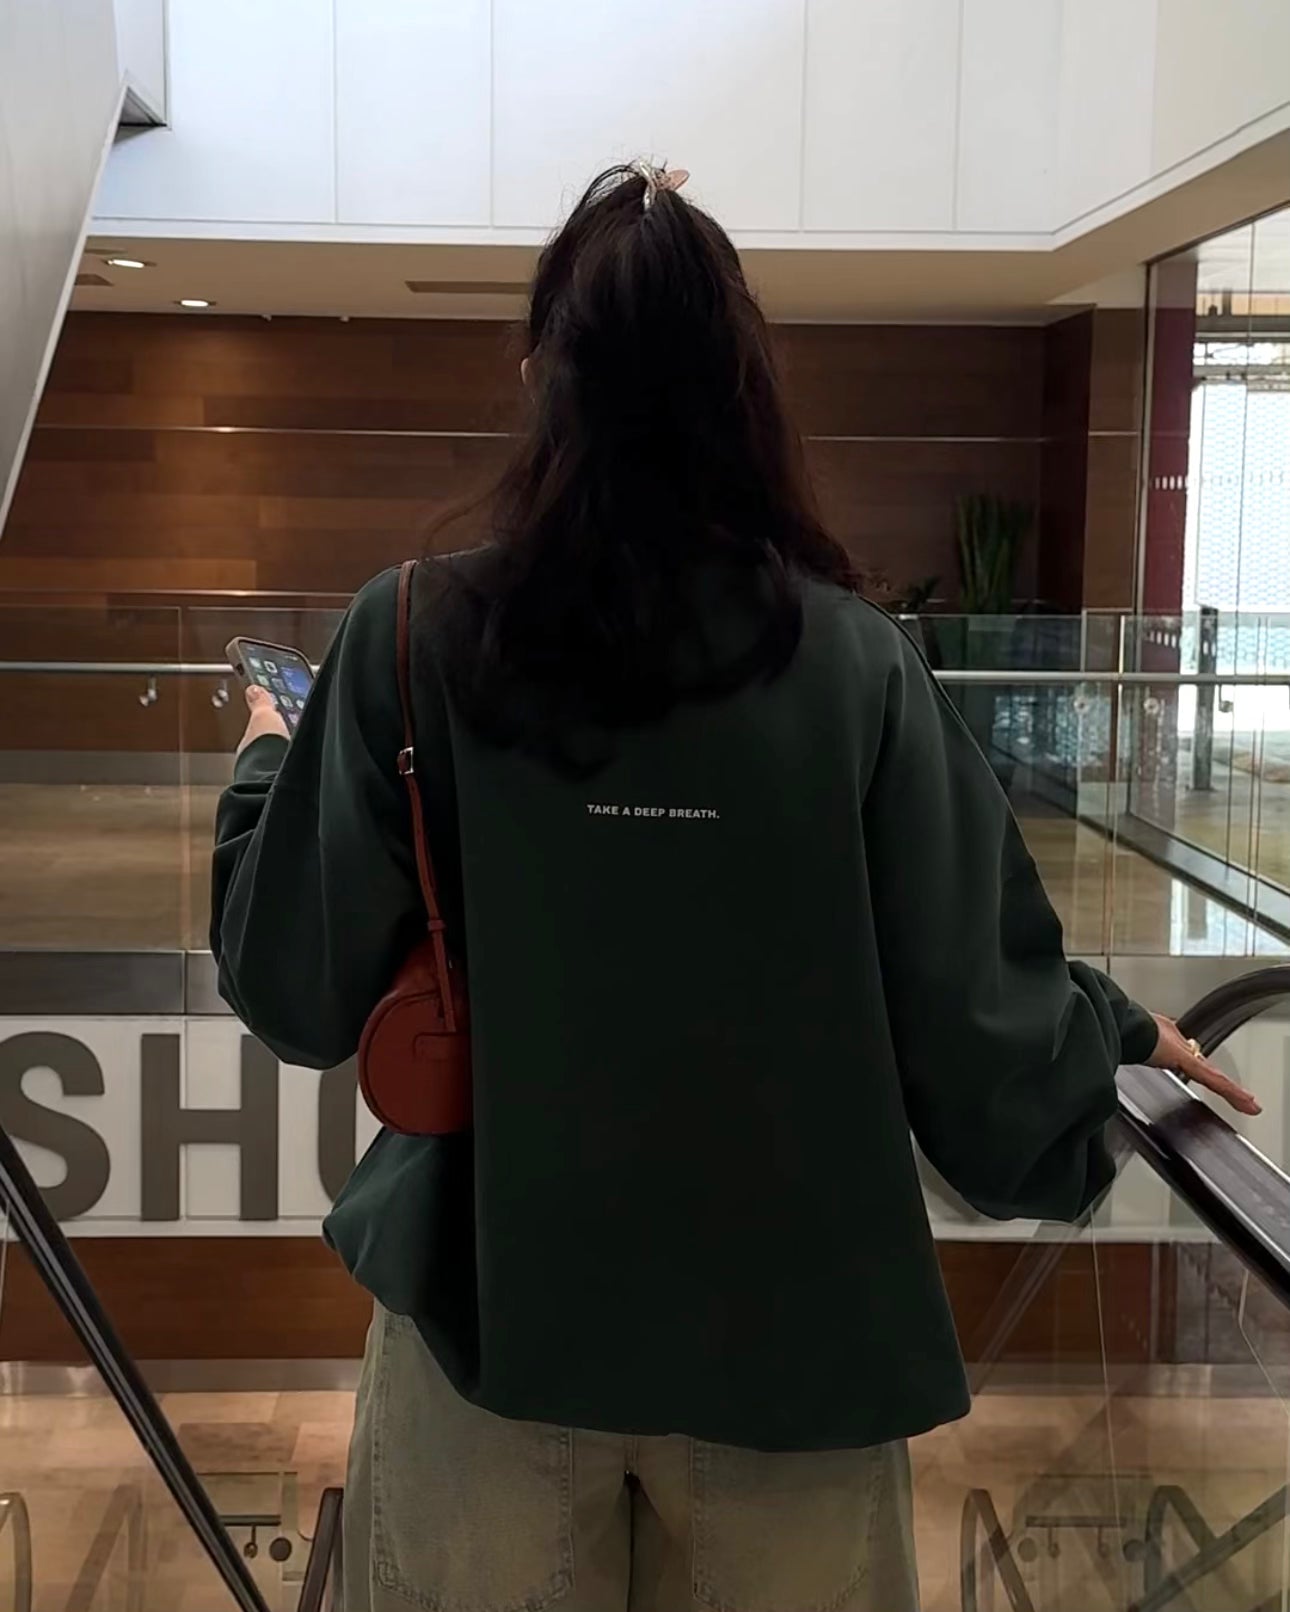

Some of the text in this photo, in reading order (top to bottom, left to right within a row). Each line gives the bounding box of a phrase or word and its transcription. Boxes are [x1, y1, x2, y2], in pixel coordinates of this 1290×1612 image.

[587, 804, 720, 819] TAKE A DEEP BREATH.
